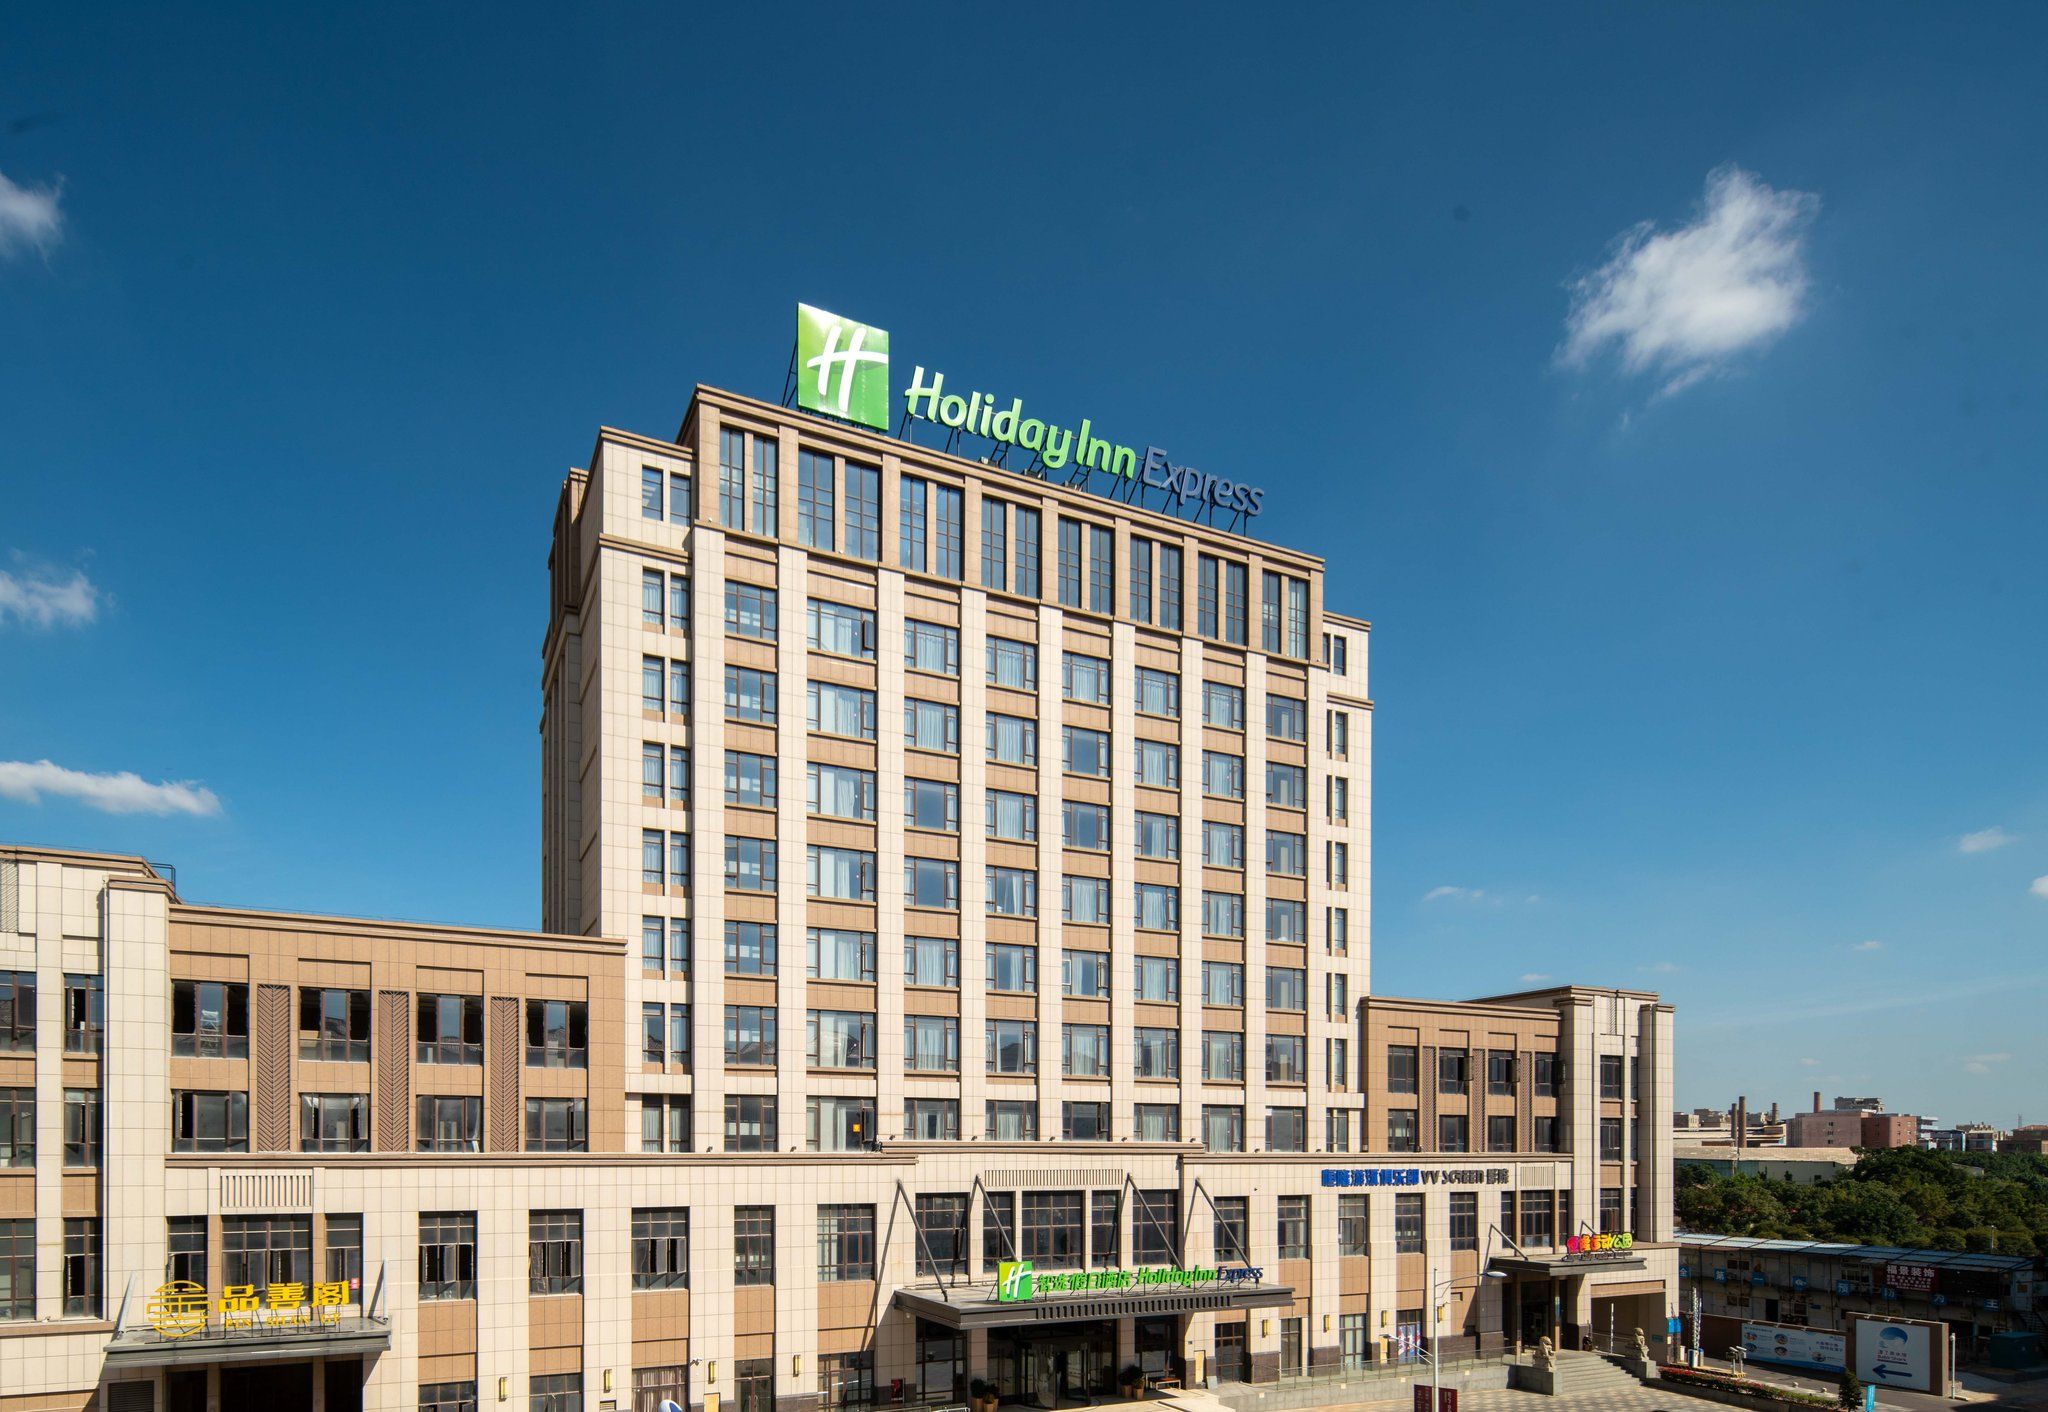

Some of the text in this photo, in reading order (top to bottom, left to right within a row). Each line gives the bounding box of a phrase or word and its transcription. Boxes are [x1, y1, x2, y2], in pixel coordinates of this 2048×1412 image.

[904, 365, 1265, 516] Holiday Inn Express
[1037, 1270, 1132, 1293] 智选假日酒店
[1137, 1264, 1263, 1287] Holiday Inn Express
